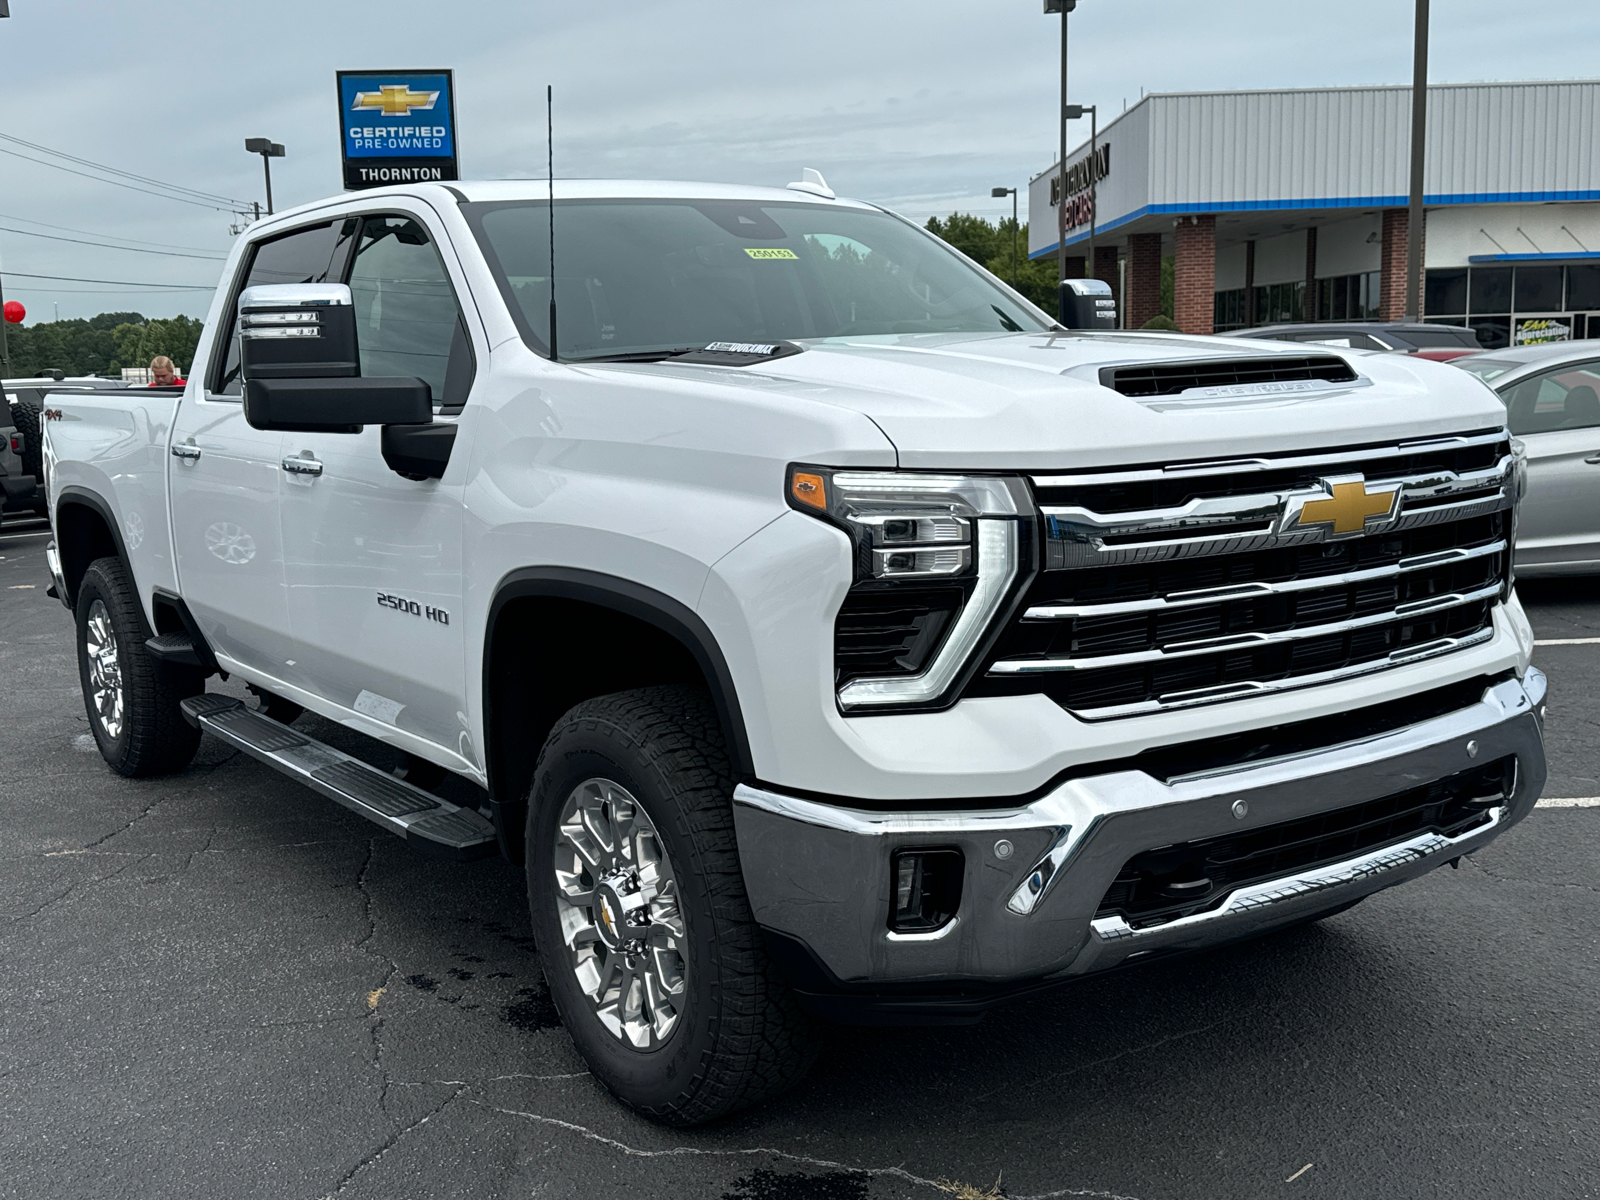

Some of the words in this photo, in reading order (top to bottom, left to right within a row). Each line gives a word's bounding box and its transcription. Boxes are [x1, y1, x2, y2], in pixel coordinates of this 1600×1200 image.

[349, 126, 446, 138] CERTIFIED
[355, 138, 442, 149] PRE-OWNED
[360, 167, 442, 181] THORNTON
[749, 250, 794, 258] 250153
[1522, 320, 1551, 329] FAN
[1517, 327, 1570, 340] Appreciation
[377, 592, 421, 617] 2500
[426, 605, 449, 625] HD
